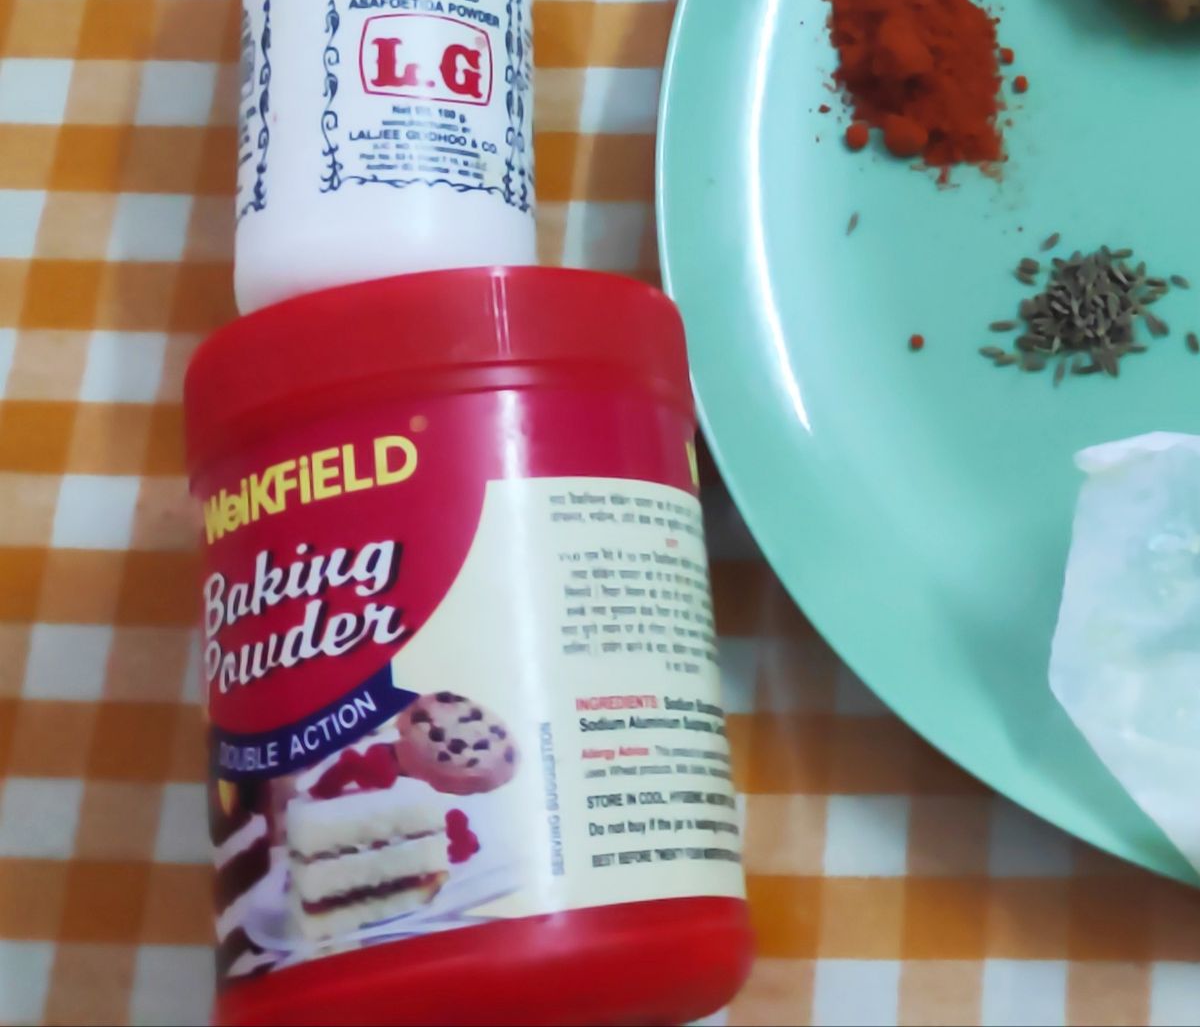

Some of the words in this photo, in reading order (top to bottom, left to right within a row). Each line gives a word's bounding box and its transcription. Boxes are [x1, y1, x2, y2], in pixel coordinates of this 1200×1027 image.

[448, 3, 500, 27] POWDER
[349, 129, 400, 141] LALJEE
[204, 540, 398, 637] Baking
[204, 599, 406, 693] Powder
[219, 740, 280, 771] DOUBLE
[289, 691, 377, 760] ACTION
[586, 793, 623, 808] STORE
[588, 823, 604, 836] Do
